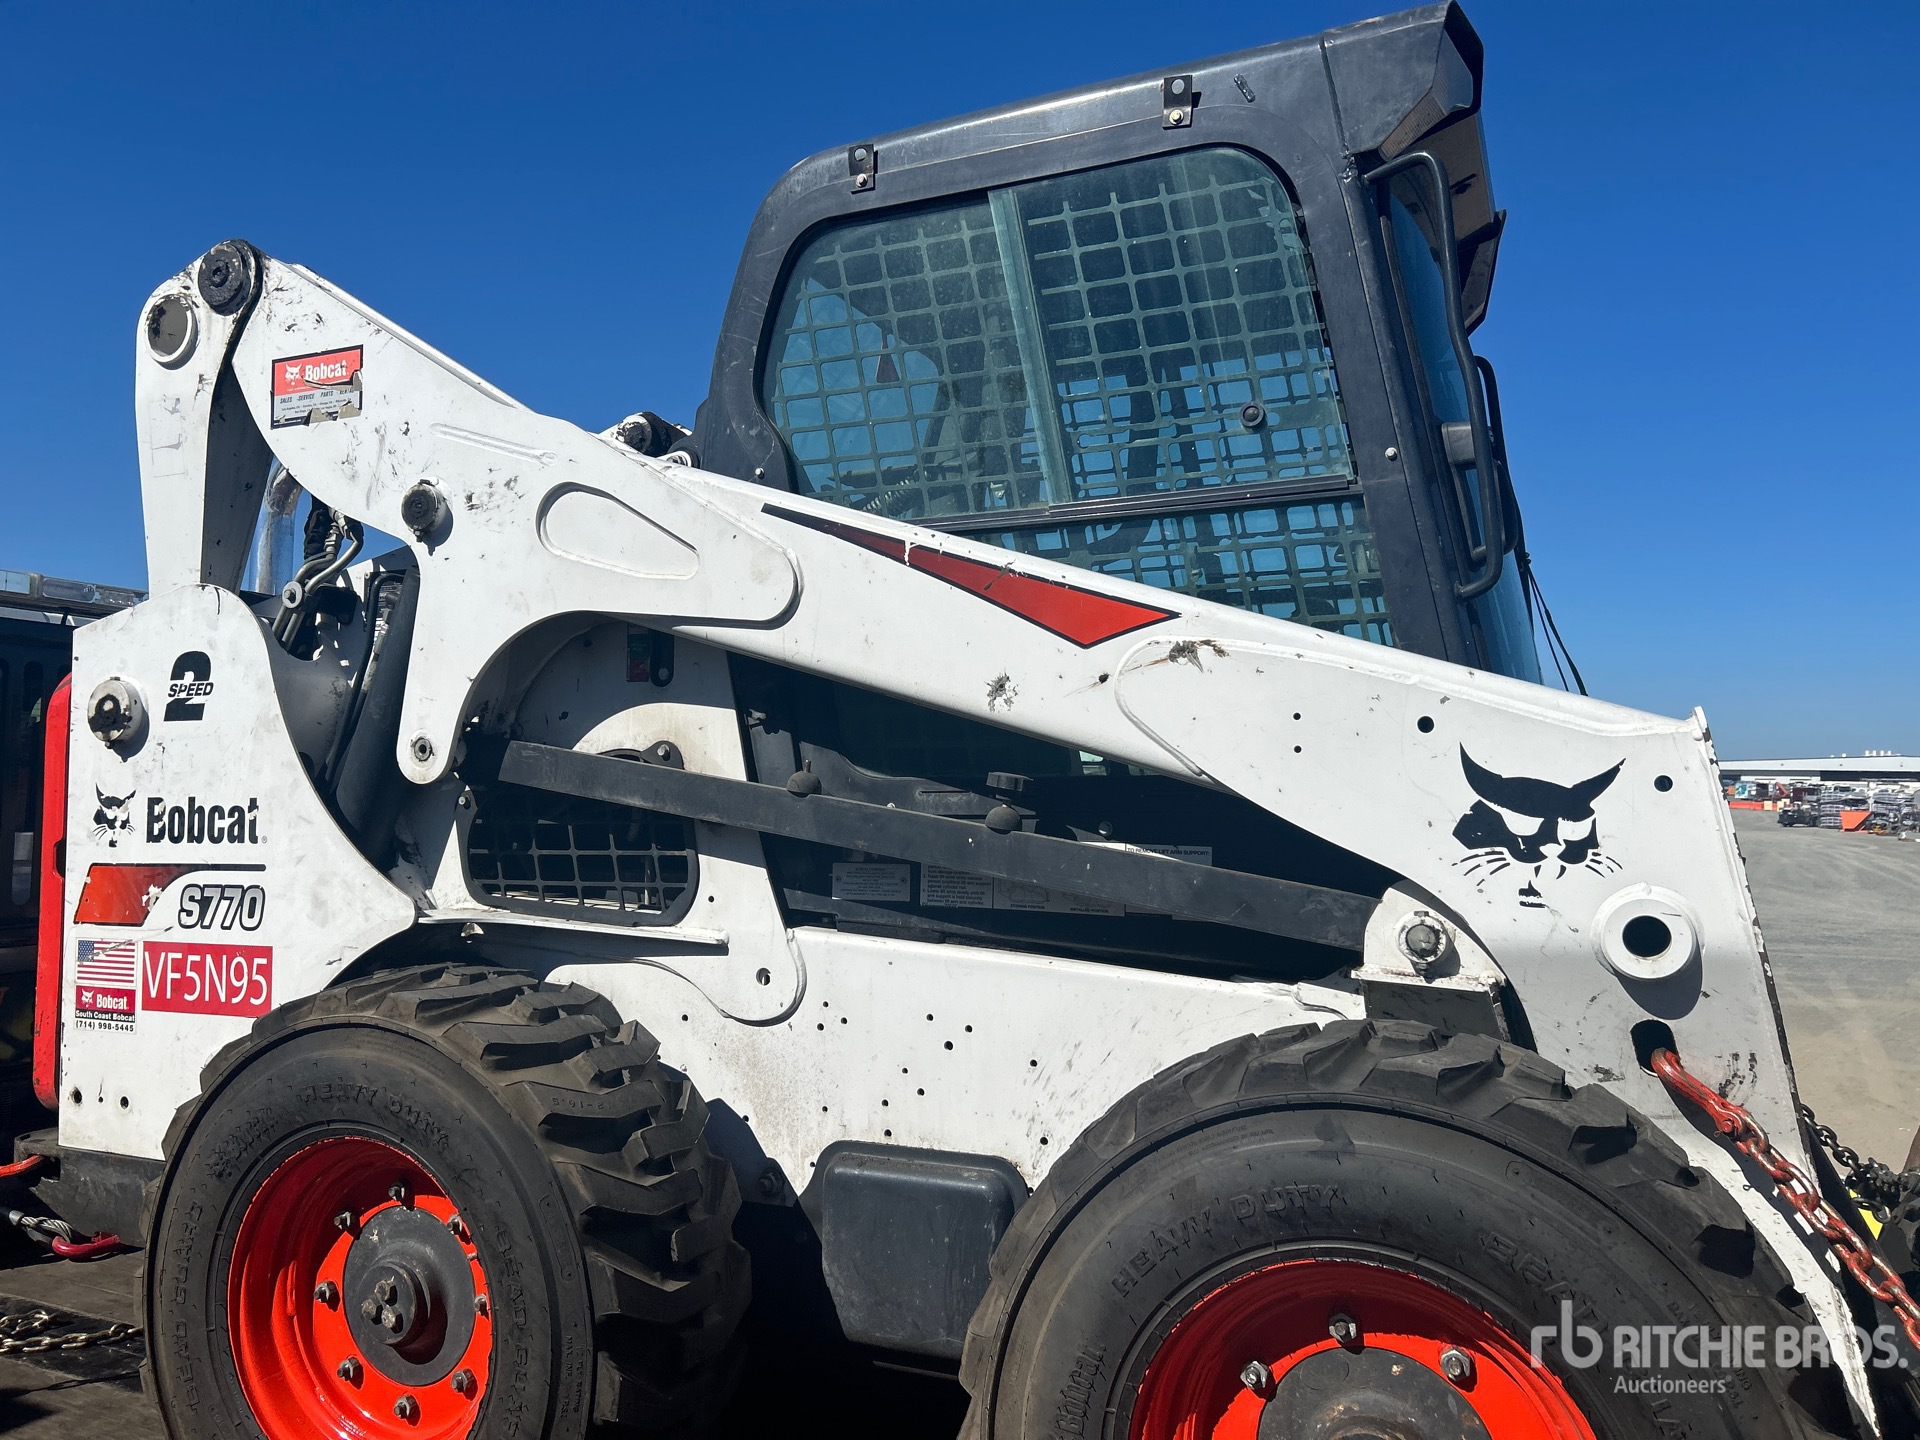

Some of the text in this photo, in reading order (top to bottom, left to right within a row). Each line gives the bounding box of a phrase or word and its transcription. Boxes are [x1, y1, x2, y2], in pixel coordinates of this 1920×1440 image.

[305, 360, 347, 380] Bobcat
[299, 393, 315, 401] SERVICE
[163, 651, 211, 721] 2
[168, 682, 214, 697] SPEED
[146, 796, 259, 844] Bobcat
[178, 884, 266, 931] S770
[144, 951, 268, 1005] VF5N95
[96, 993, 128, 1010] Bobcat
[76, 1010, 135, 1022] South Coast Bobcat
[76, 1020, 134, 1032] (714) 998-5445
[1110, 1183, 1340, 1298] HEAVY DUTY
